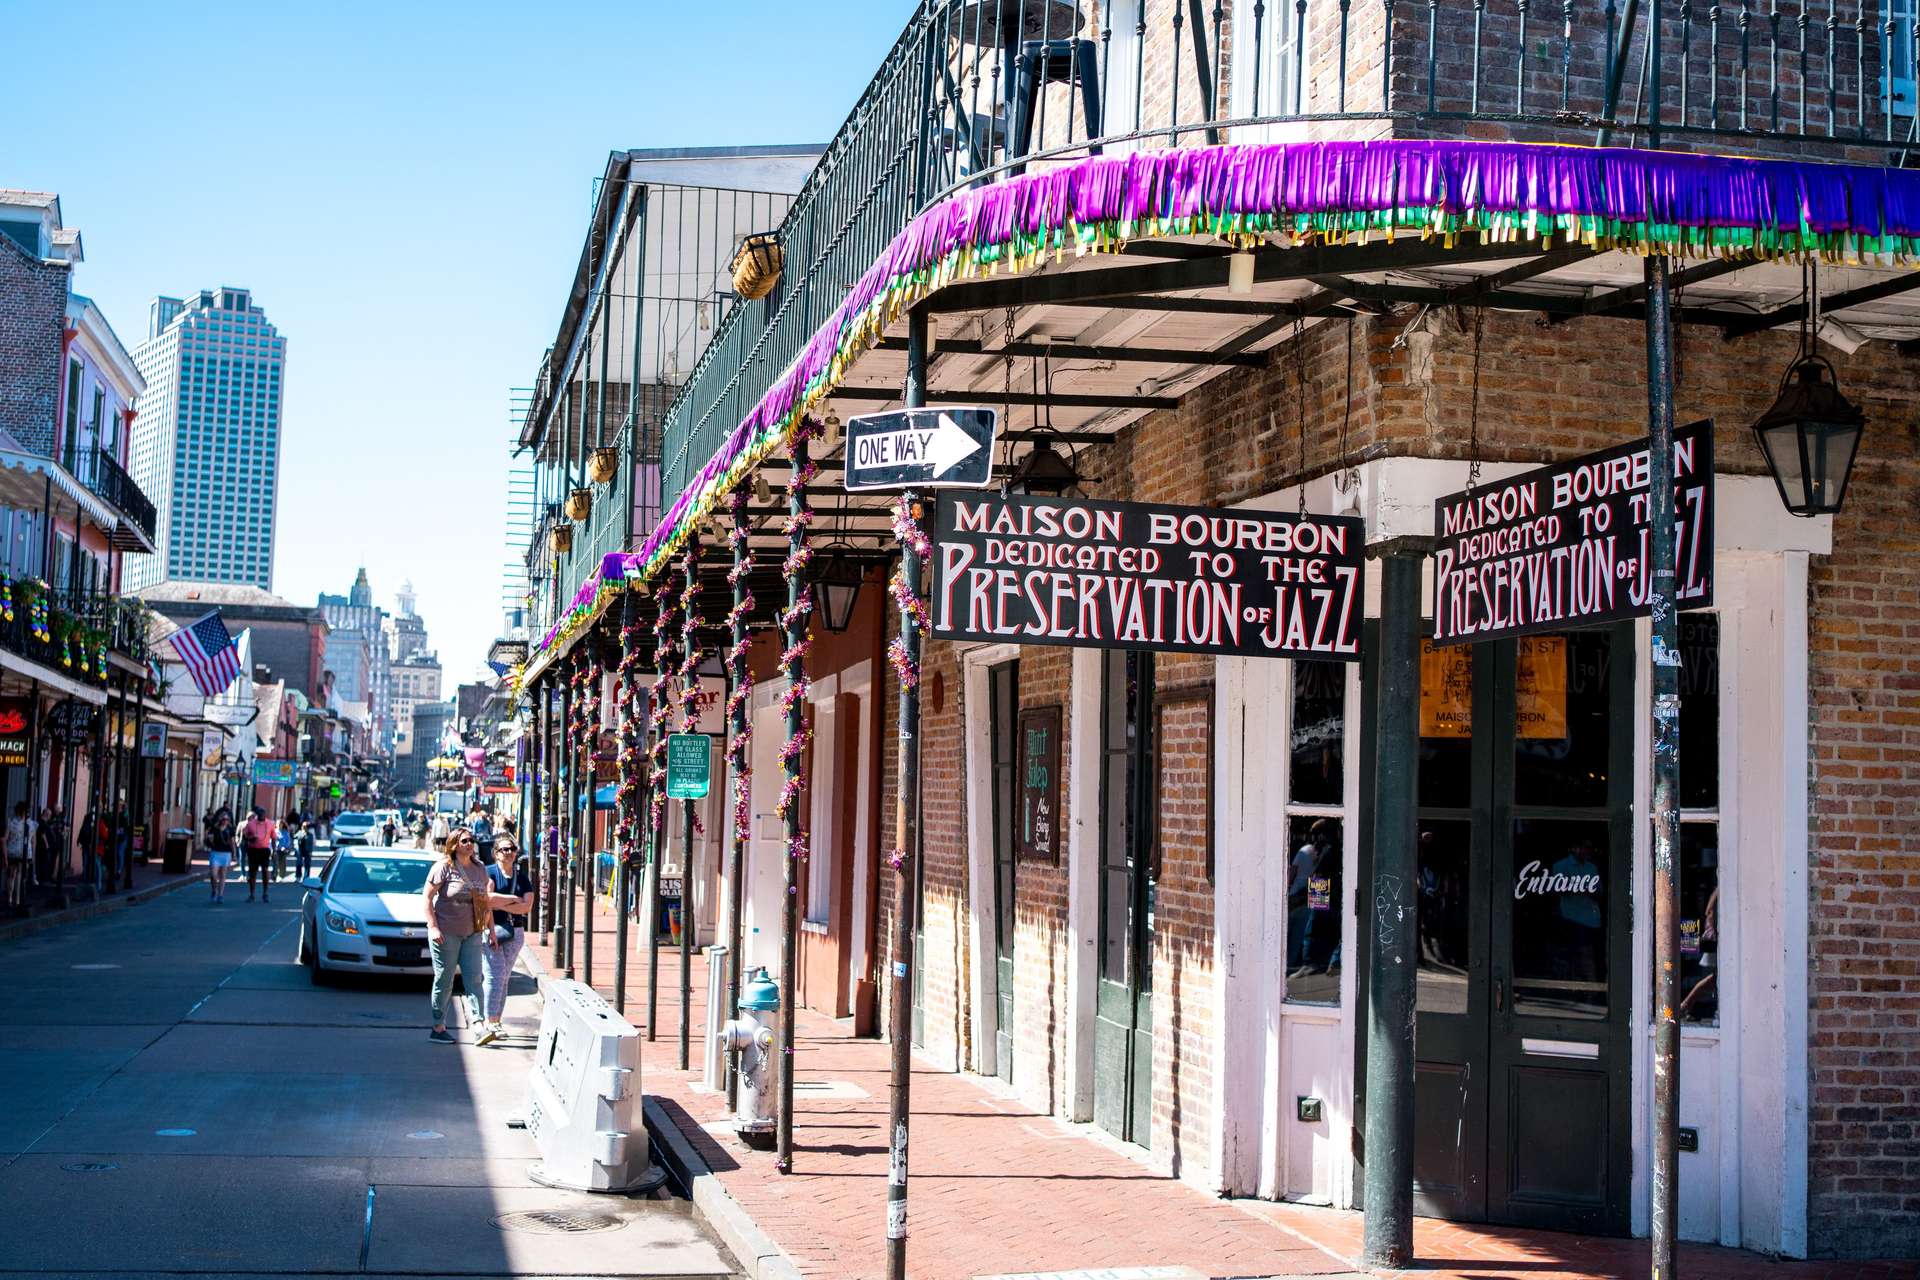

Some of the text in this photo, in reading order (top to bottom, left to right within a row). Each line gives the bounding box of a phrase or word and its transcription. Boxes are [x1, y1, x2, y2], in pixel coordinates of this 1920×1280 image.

[860, 433, 933, 465] ONE WAY
[1443, 482, 1538, 538] MAISON
[1551, 436, 1695, 510] BOURBN
[953, 501, 1347, 555] MAISON BOURBON
[1459, 515, 1562, 565] DEDICATED
[1578, 502, 1612, 536] TO
[985, 538, 1328, 584] DEDICATED TO THE
[1433, 535, 1617, 639] PRESERVATION
[1616, 558, 1639, 580] OF
[935, 542, 1359, 654] PRESERVATION OF JAZZ
[1538, 641, 1559, 653] ST
[1514, 859, 1600, 900] Entrance
